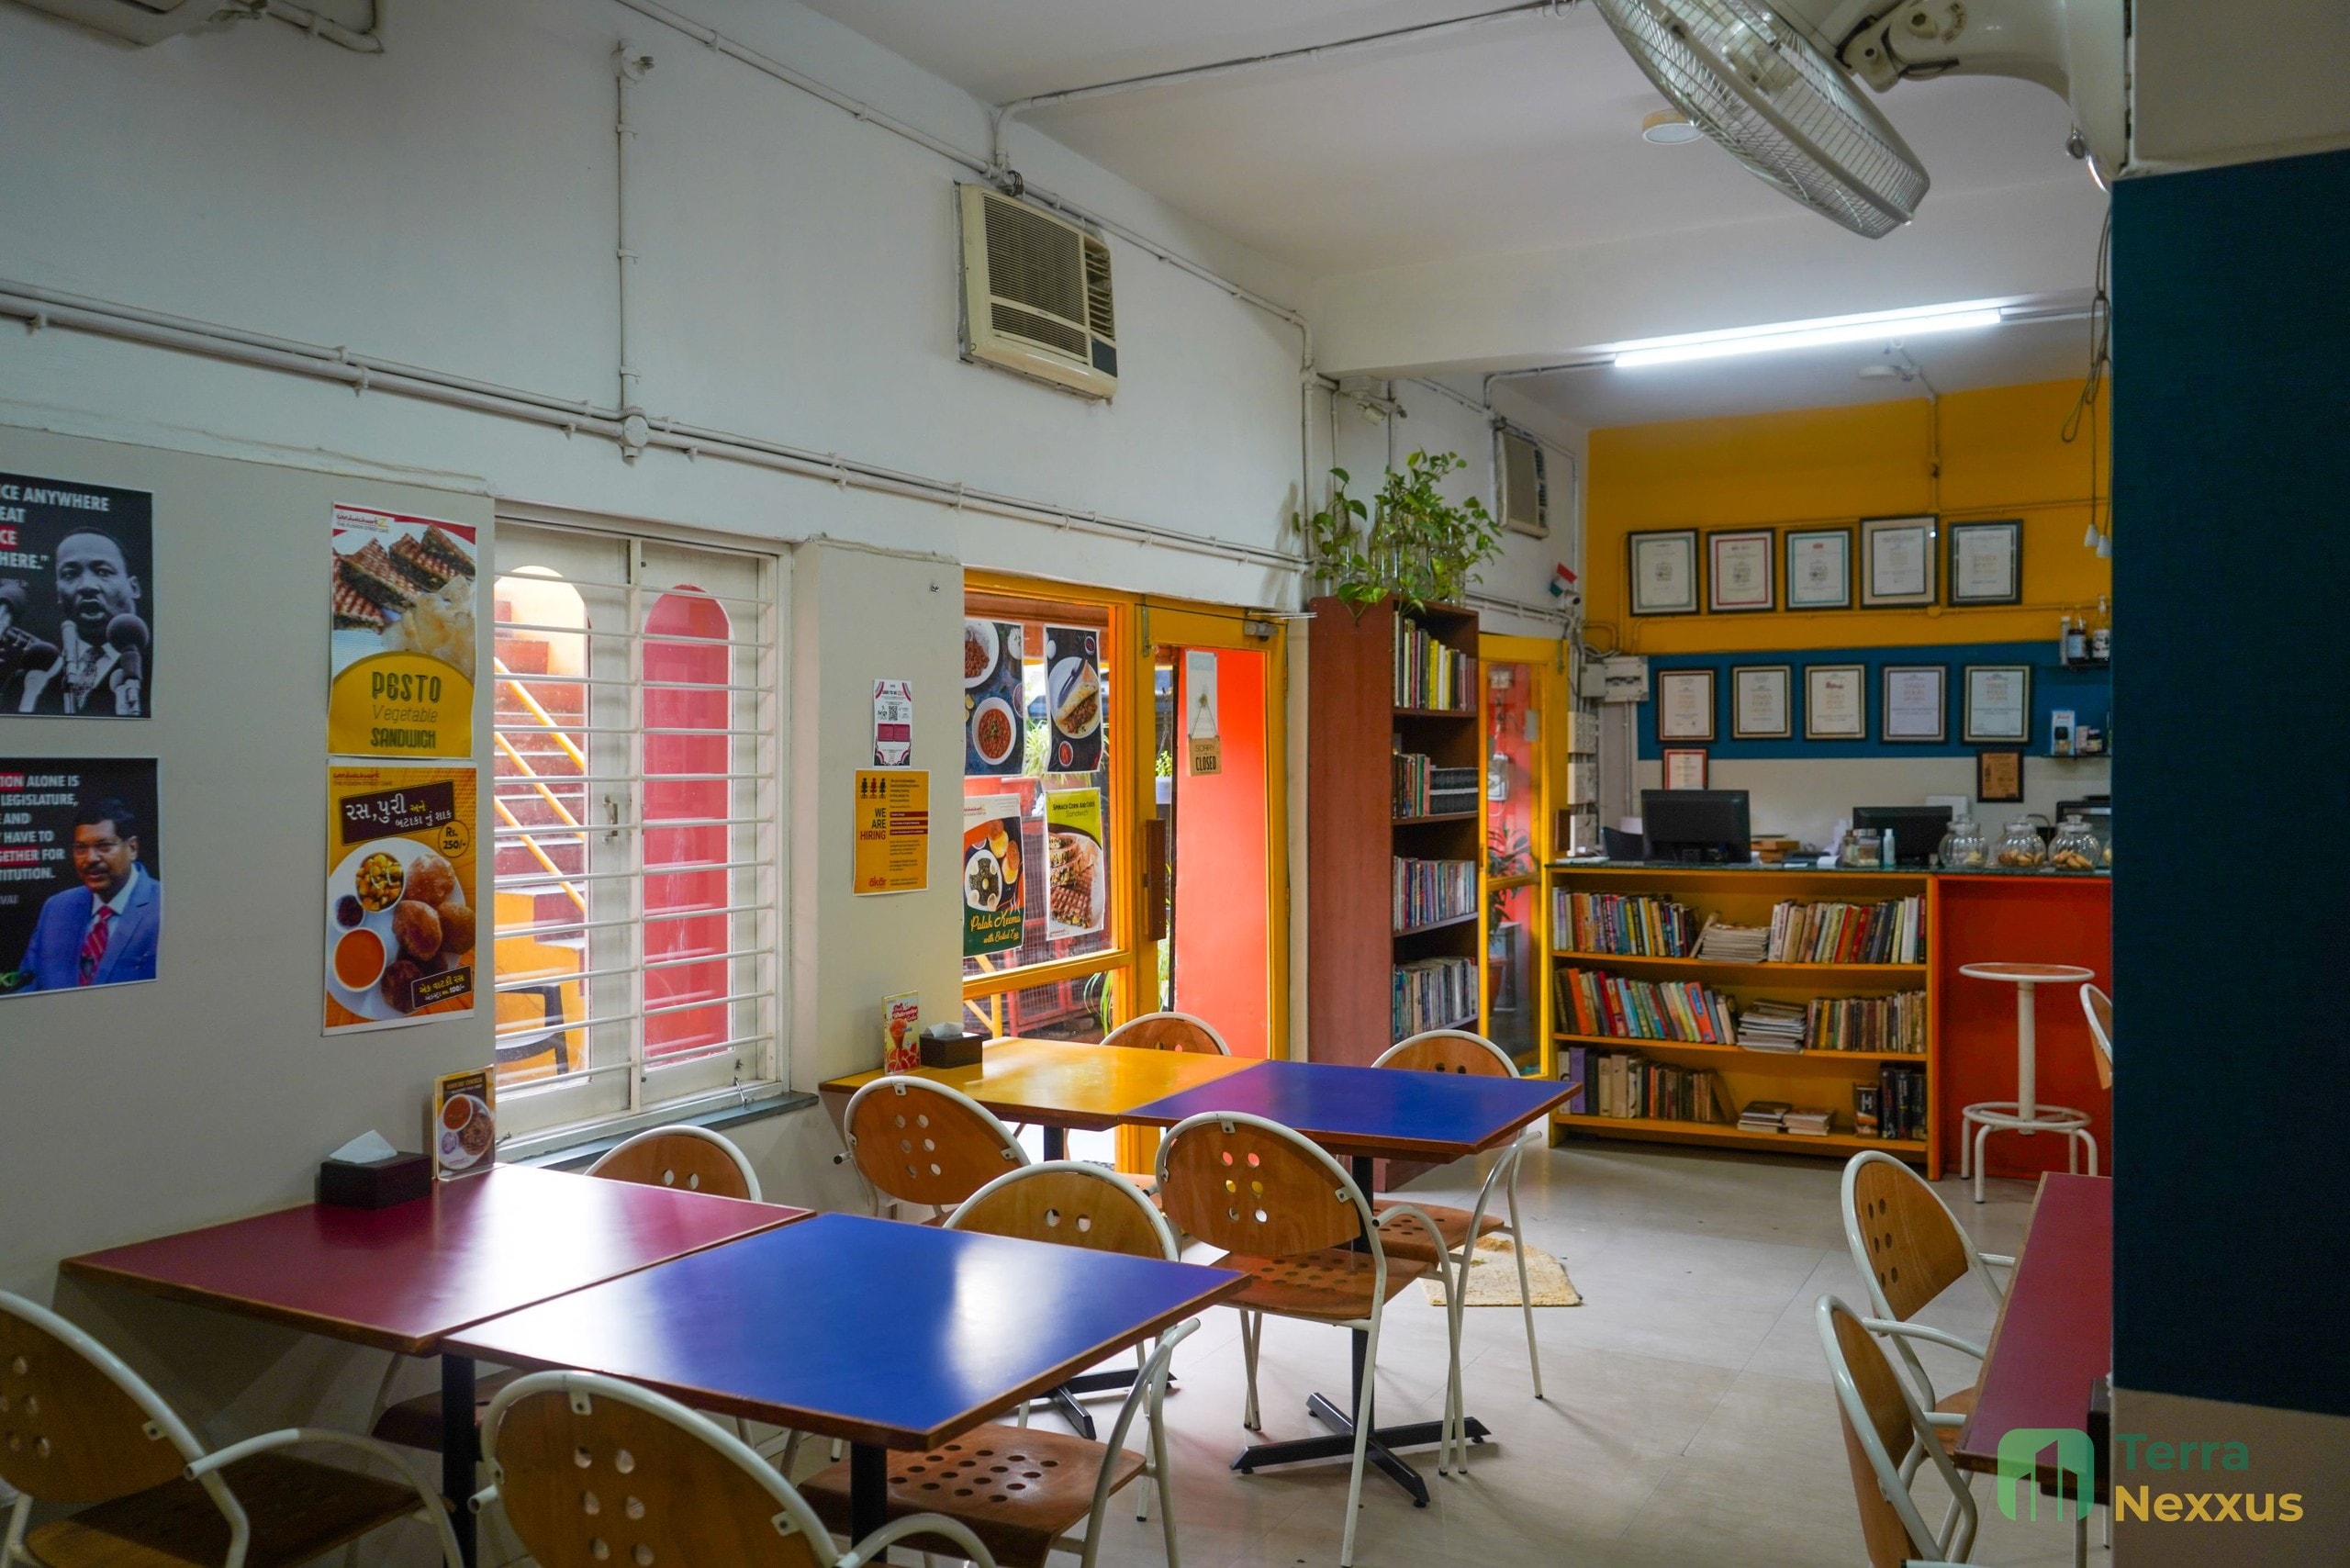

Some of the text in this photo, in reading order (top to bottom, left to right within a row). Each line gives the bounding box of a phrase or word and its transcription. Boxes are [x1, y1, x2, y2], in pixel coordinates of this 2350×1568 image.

[0, 484, 110, 511] CE ANYWHERE
[372, 671, 442, 703] PESTO
[372, 704, 439, 723] Vegetable
[371, 728, 436, 749] SANDWICH
[1195, 756, 1216, 771] CLOSED
[0, 775, 80, 787] ION ALONE IS
[1, 793, 79, 807] LEGISLATURE,
[4, 812, 31, 824] AND
[875, 808, 886, 817] WE
[871, 819, 886, 829] ARE
[4, 830, 54, 843] HAVE TO
[446, 827, 457, 836] Rs.
[860, 831, 886, 840] HIRING
[443, 839, 466, 849] 250/-
[42, 848, 65, 860] FOR
[970, 910, 1021, 933] Palak Keema
[984, 933, 994, 943] with
